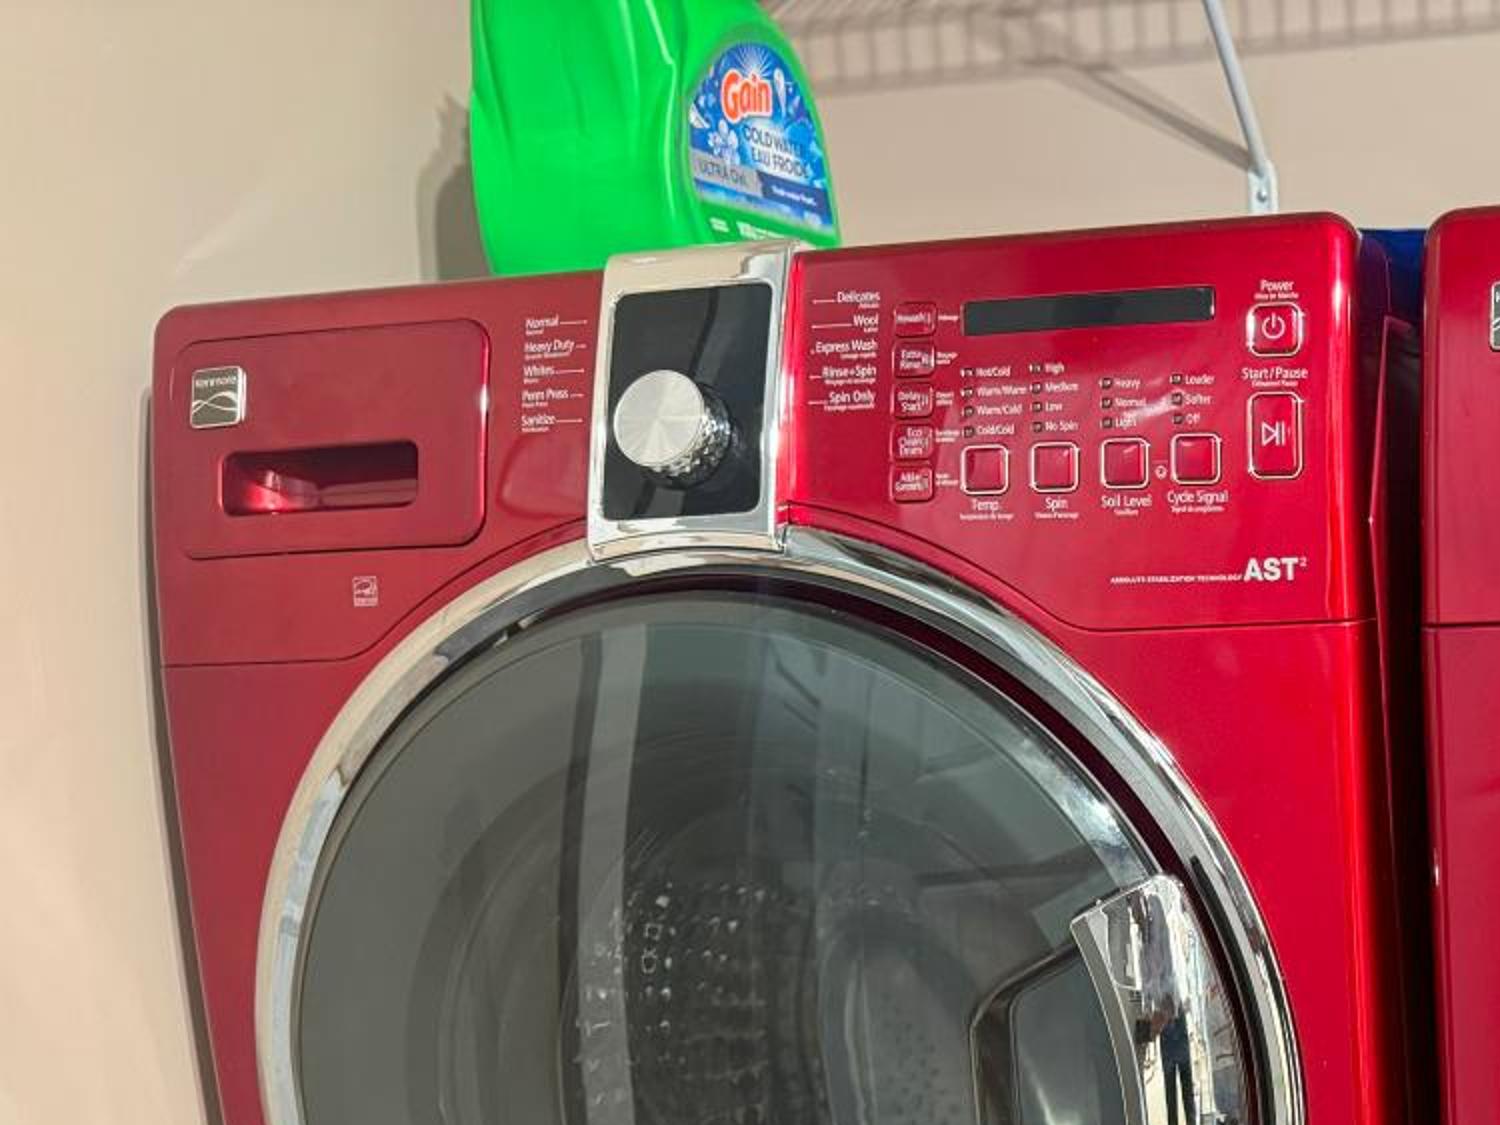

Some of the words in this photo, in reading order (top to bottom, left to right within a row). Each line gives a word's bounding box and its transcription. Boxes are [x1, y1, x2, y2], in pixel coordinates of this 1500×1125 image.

[721, 69, 773, 123] Gain
[1260, 279, 1294, 293] Power
[526, 315, 559, 329] Normal
[853, 314, 879, 328] Wool
[816, 341, 850, 356] Express
[1185, 373, 1215, 385] Louder
[1045, 497, 1069, 512] Spin
[1101, 494, 1121, 508] Soil
[1123, 494, 1152, 507] Level
[1167, 490, 1195, 505] Cycle
[1196, 489, 1229, 506] Signal
